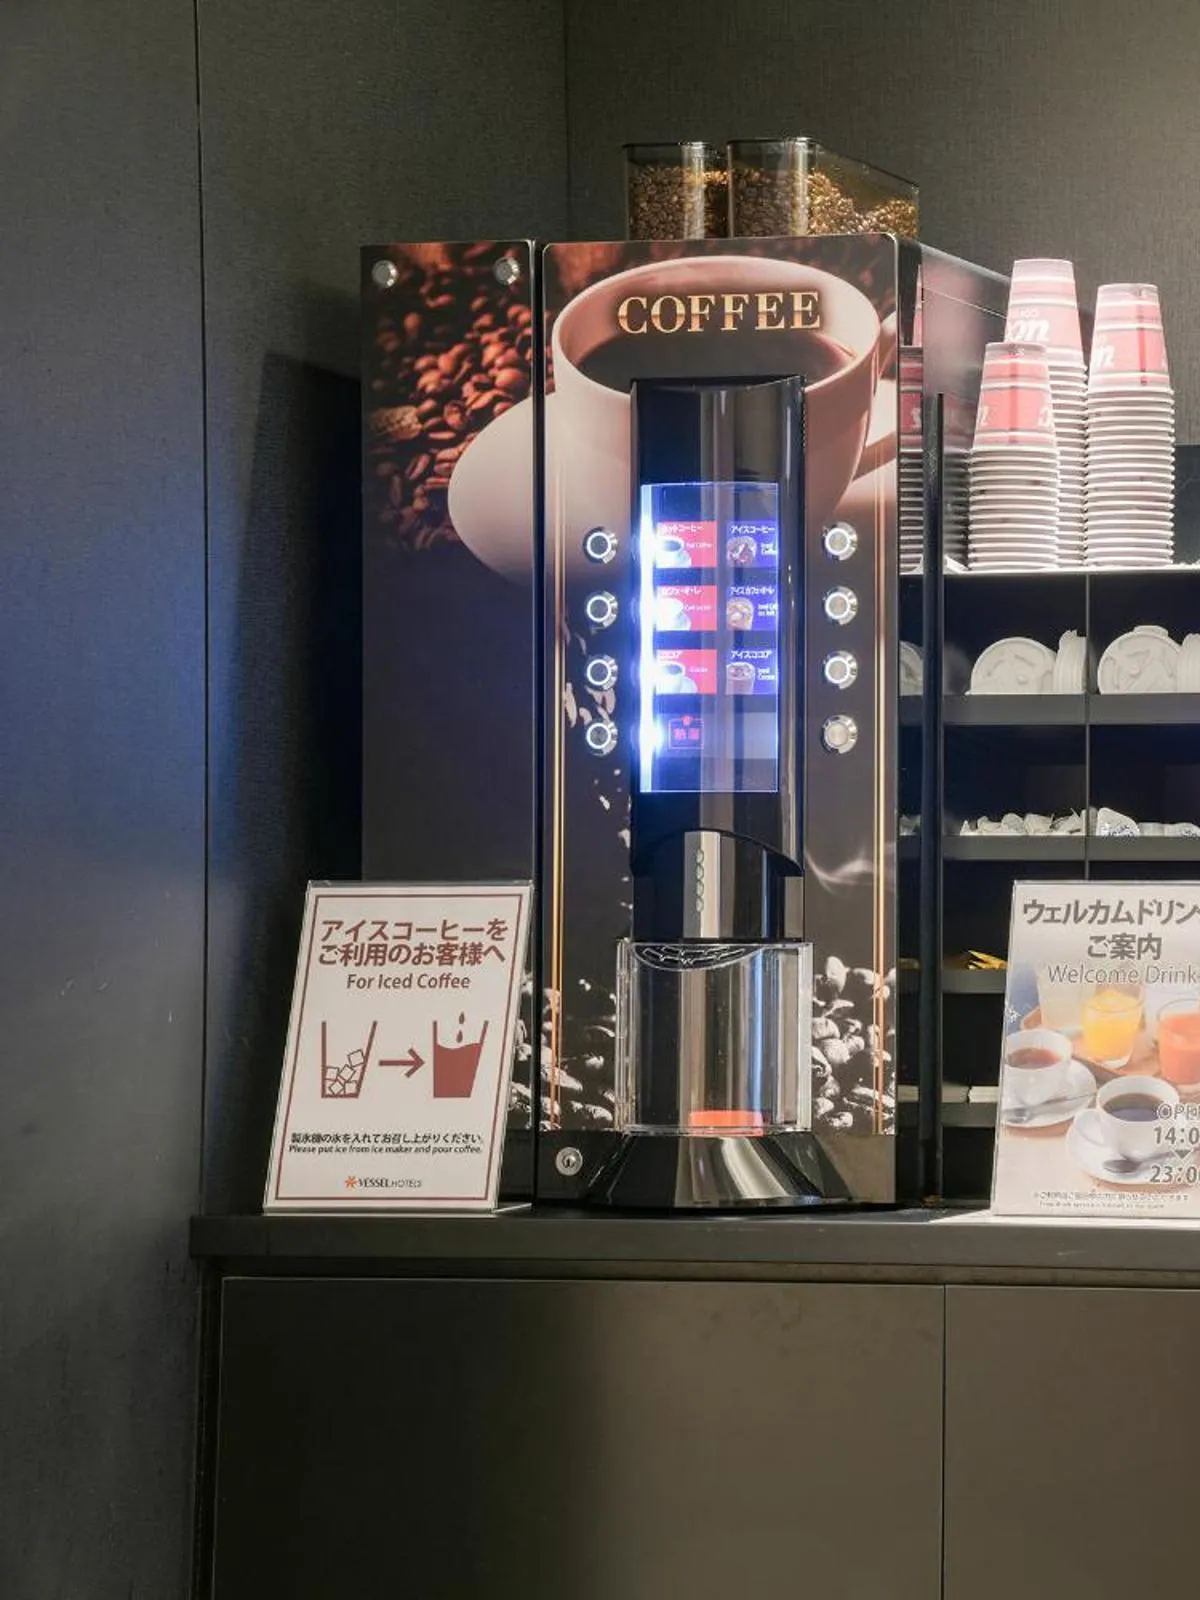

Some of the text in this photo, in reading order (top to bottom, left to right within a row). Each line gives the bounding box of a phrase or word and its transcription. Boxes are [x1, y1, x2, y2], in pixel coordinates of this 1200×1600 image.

[617, 292, 821, 334] COFFEE
[730, 525, 776, 534] アイスコーヒー
[319, 918, 509, 942] アイスコーヒーを
[317, 941, 507, 967] ご利用のお客様へ
[1087, 933, 1162, 961] ご案内
[346, 973, 471, 990] For Iced Coffee
[1048, 964, 1197, 985] Welcome Drink
[288, 1145, 316, 1154] Please
[317, 1146, 333, 1155] put
[348, 1145, 370, 1154] from
[371, 1145, 383, 1153] ice
[384, 1145, 413, 1154] maker
[414, 1145, 430, 1154] and
[431, 1147, 452, 1156] pour
[453, 1145, 482, 1154] coffee.
[358, 1178, 422, 1188] VESSEL HOTELS
